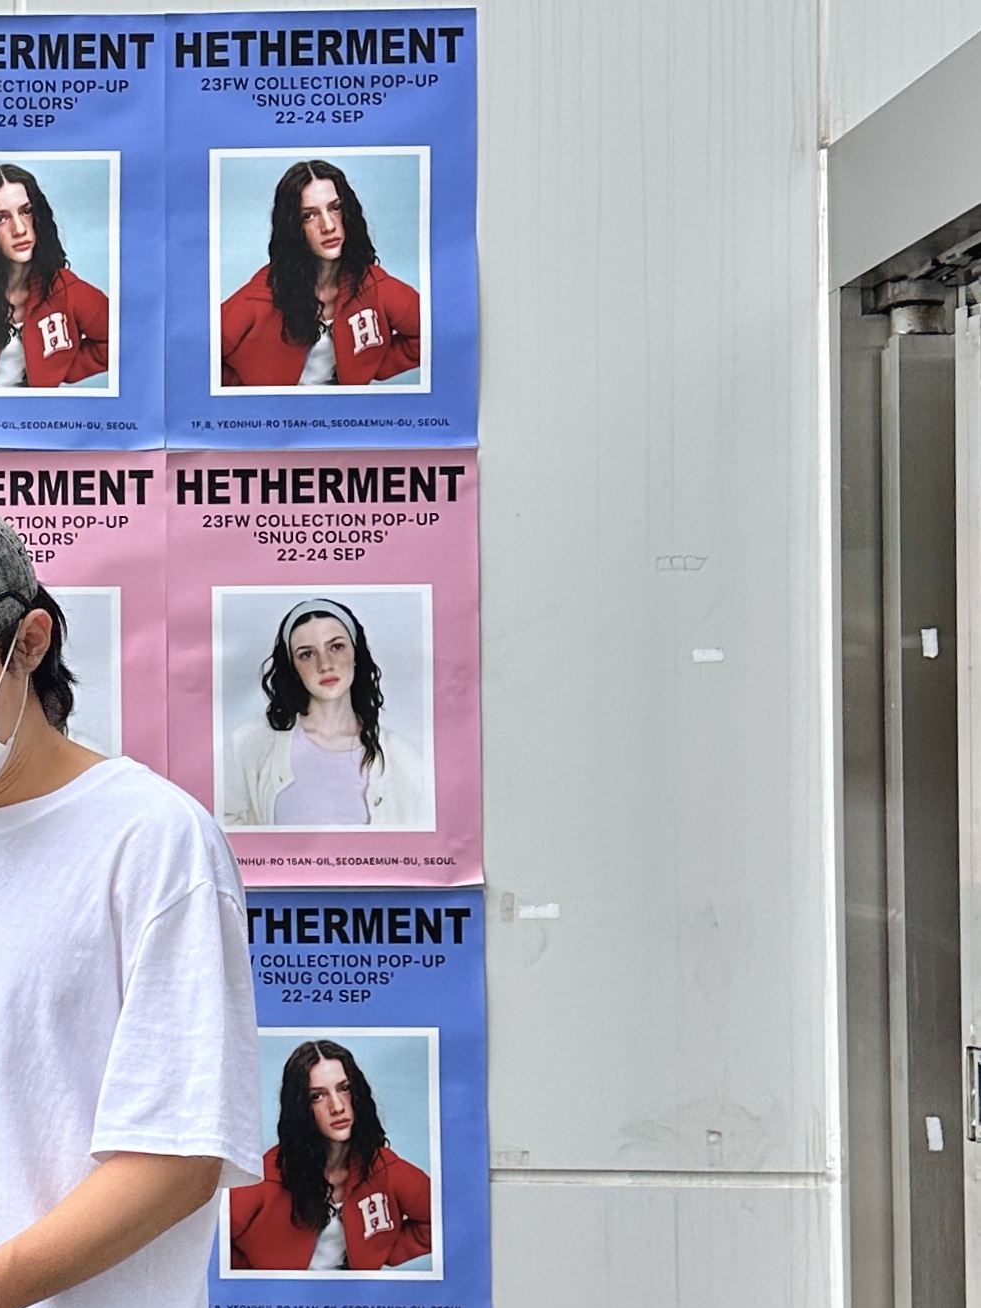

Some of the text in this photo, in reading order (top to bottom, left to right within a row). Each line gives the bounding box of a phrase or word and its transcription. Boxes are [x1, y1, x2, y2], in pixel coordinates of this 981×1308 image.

[175, 27, 464, 68] HETHERMENT
[62, 79, 129, 93] POP-UP
[201, 73, 438, 91] 23FW COLLECTION POP-UP
[3, 96, 77, 110] COLORS'
[252, 92, 386, 107] 'SNUG COLORS'
[22, 114, 55, 127] SEP
[275, 110, 363, 124] 22-24 SEP
[106, 421, 138, 430] SEOUL
[417, 418, 450, 426] SEOUL
[176, 465, 465, 504] HETHERMENT
[62, 515, 128, 528] POP-UP
[202, 512, 439, 527] 23FW COLLECTION POP-UP
[253, 529, 387, 544] 'SNUG COLORS'
[277, 547, 365, 561] 22-24 SEP
[423, 856, 456, 865] SEOUL
[246, 907, 471, 944] THERMENT
[260, 954, 371, 967] COLLECTION
[377, 954, 445, 967] POP-UP
[258, 971, 394, 985] 'SNUG COLORS'
[281, 989, 371, 1002] 22-24 SEP
